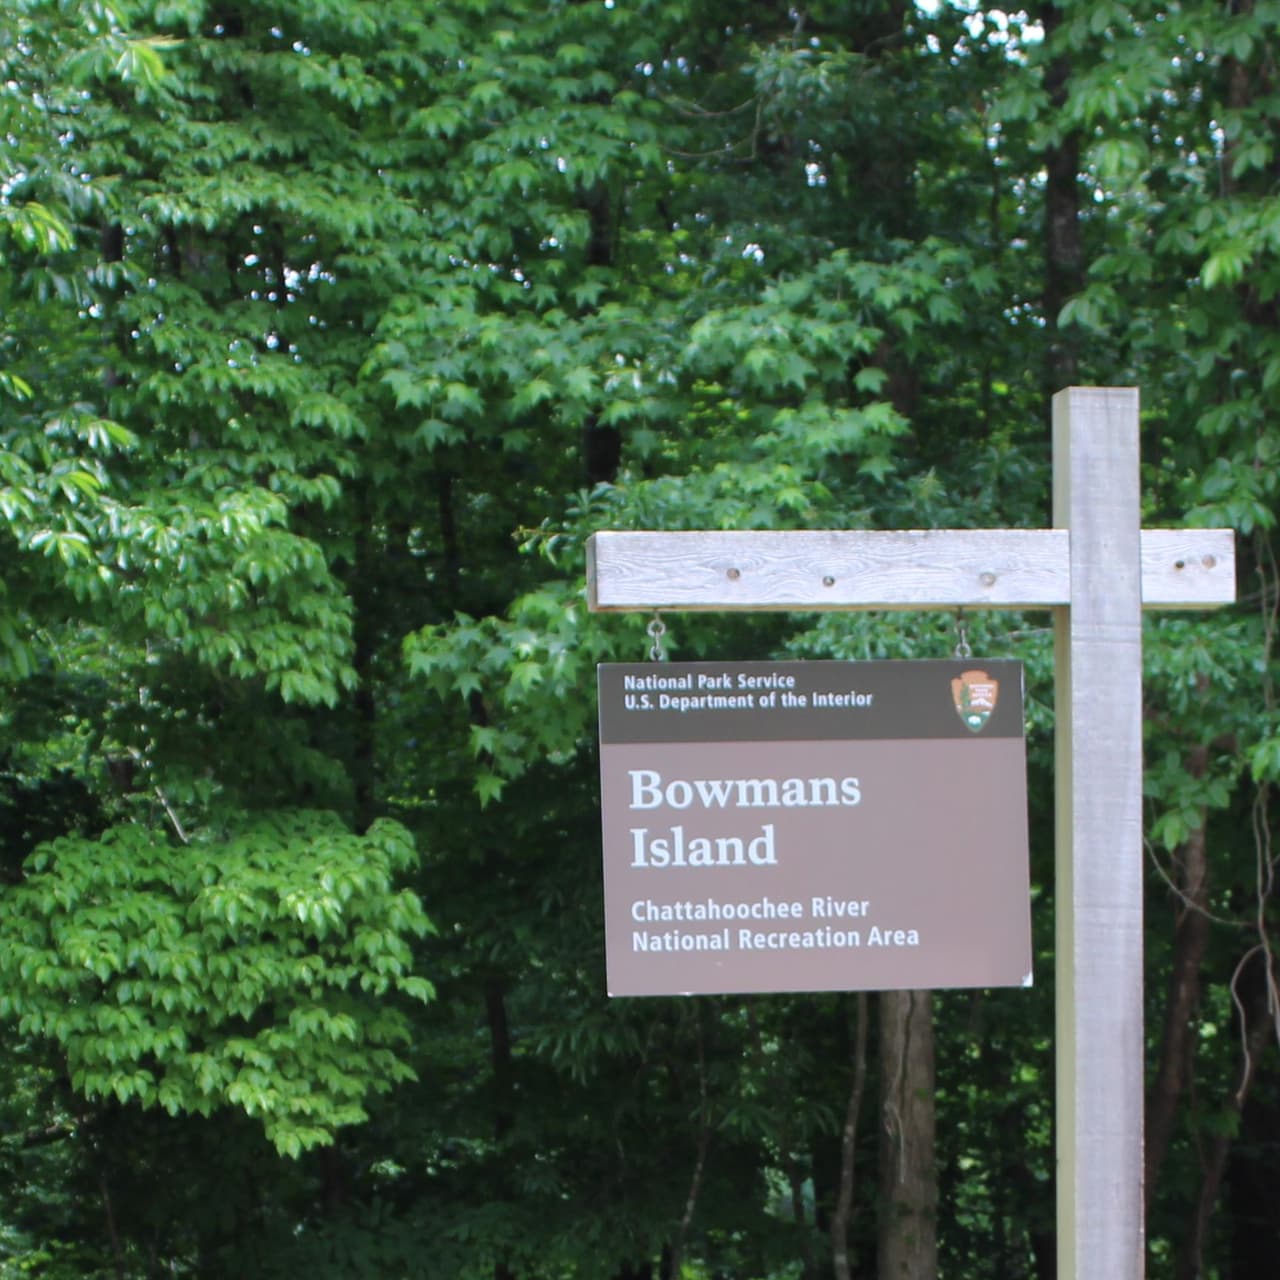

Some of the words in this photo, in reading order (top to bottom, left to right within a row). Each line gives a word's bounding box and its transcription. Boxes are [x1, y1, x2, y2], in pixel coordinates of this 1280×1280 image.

[624, 673, 692, 690] National
[698, 673, 732, 689] Park
[737, 673, 795, 689] Service
[624, 694, 654, 710] U.S.
[659, 693, 754, 712] Department
[759, 691, 776, 708] of
[780, 692, 807, 708] the
[812, 690, 873, 707] Interior
[628, 770, 861, 810] Bowmans
[629, 823, 778, 867] Island
[631, 897, 803, 922] Chattahoochee
[811, 896, 870, 918] River
[632, 928, 730, 952] National
[738, 926, 860, 950] Recreation
[867, 925, 919, 947] Area
